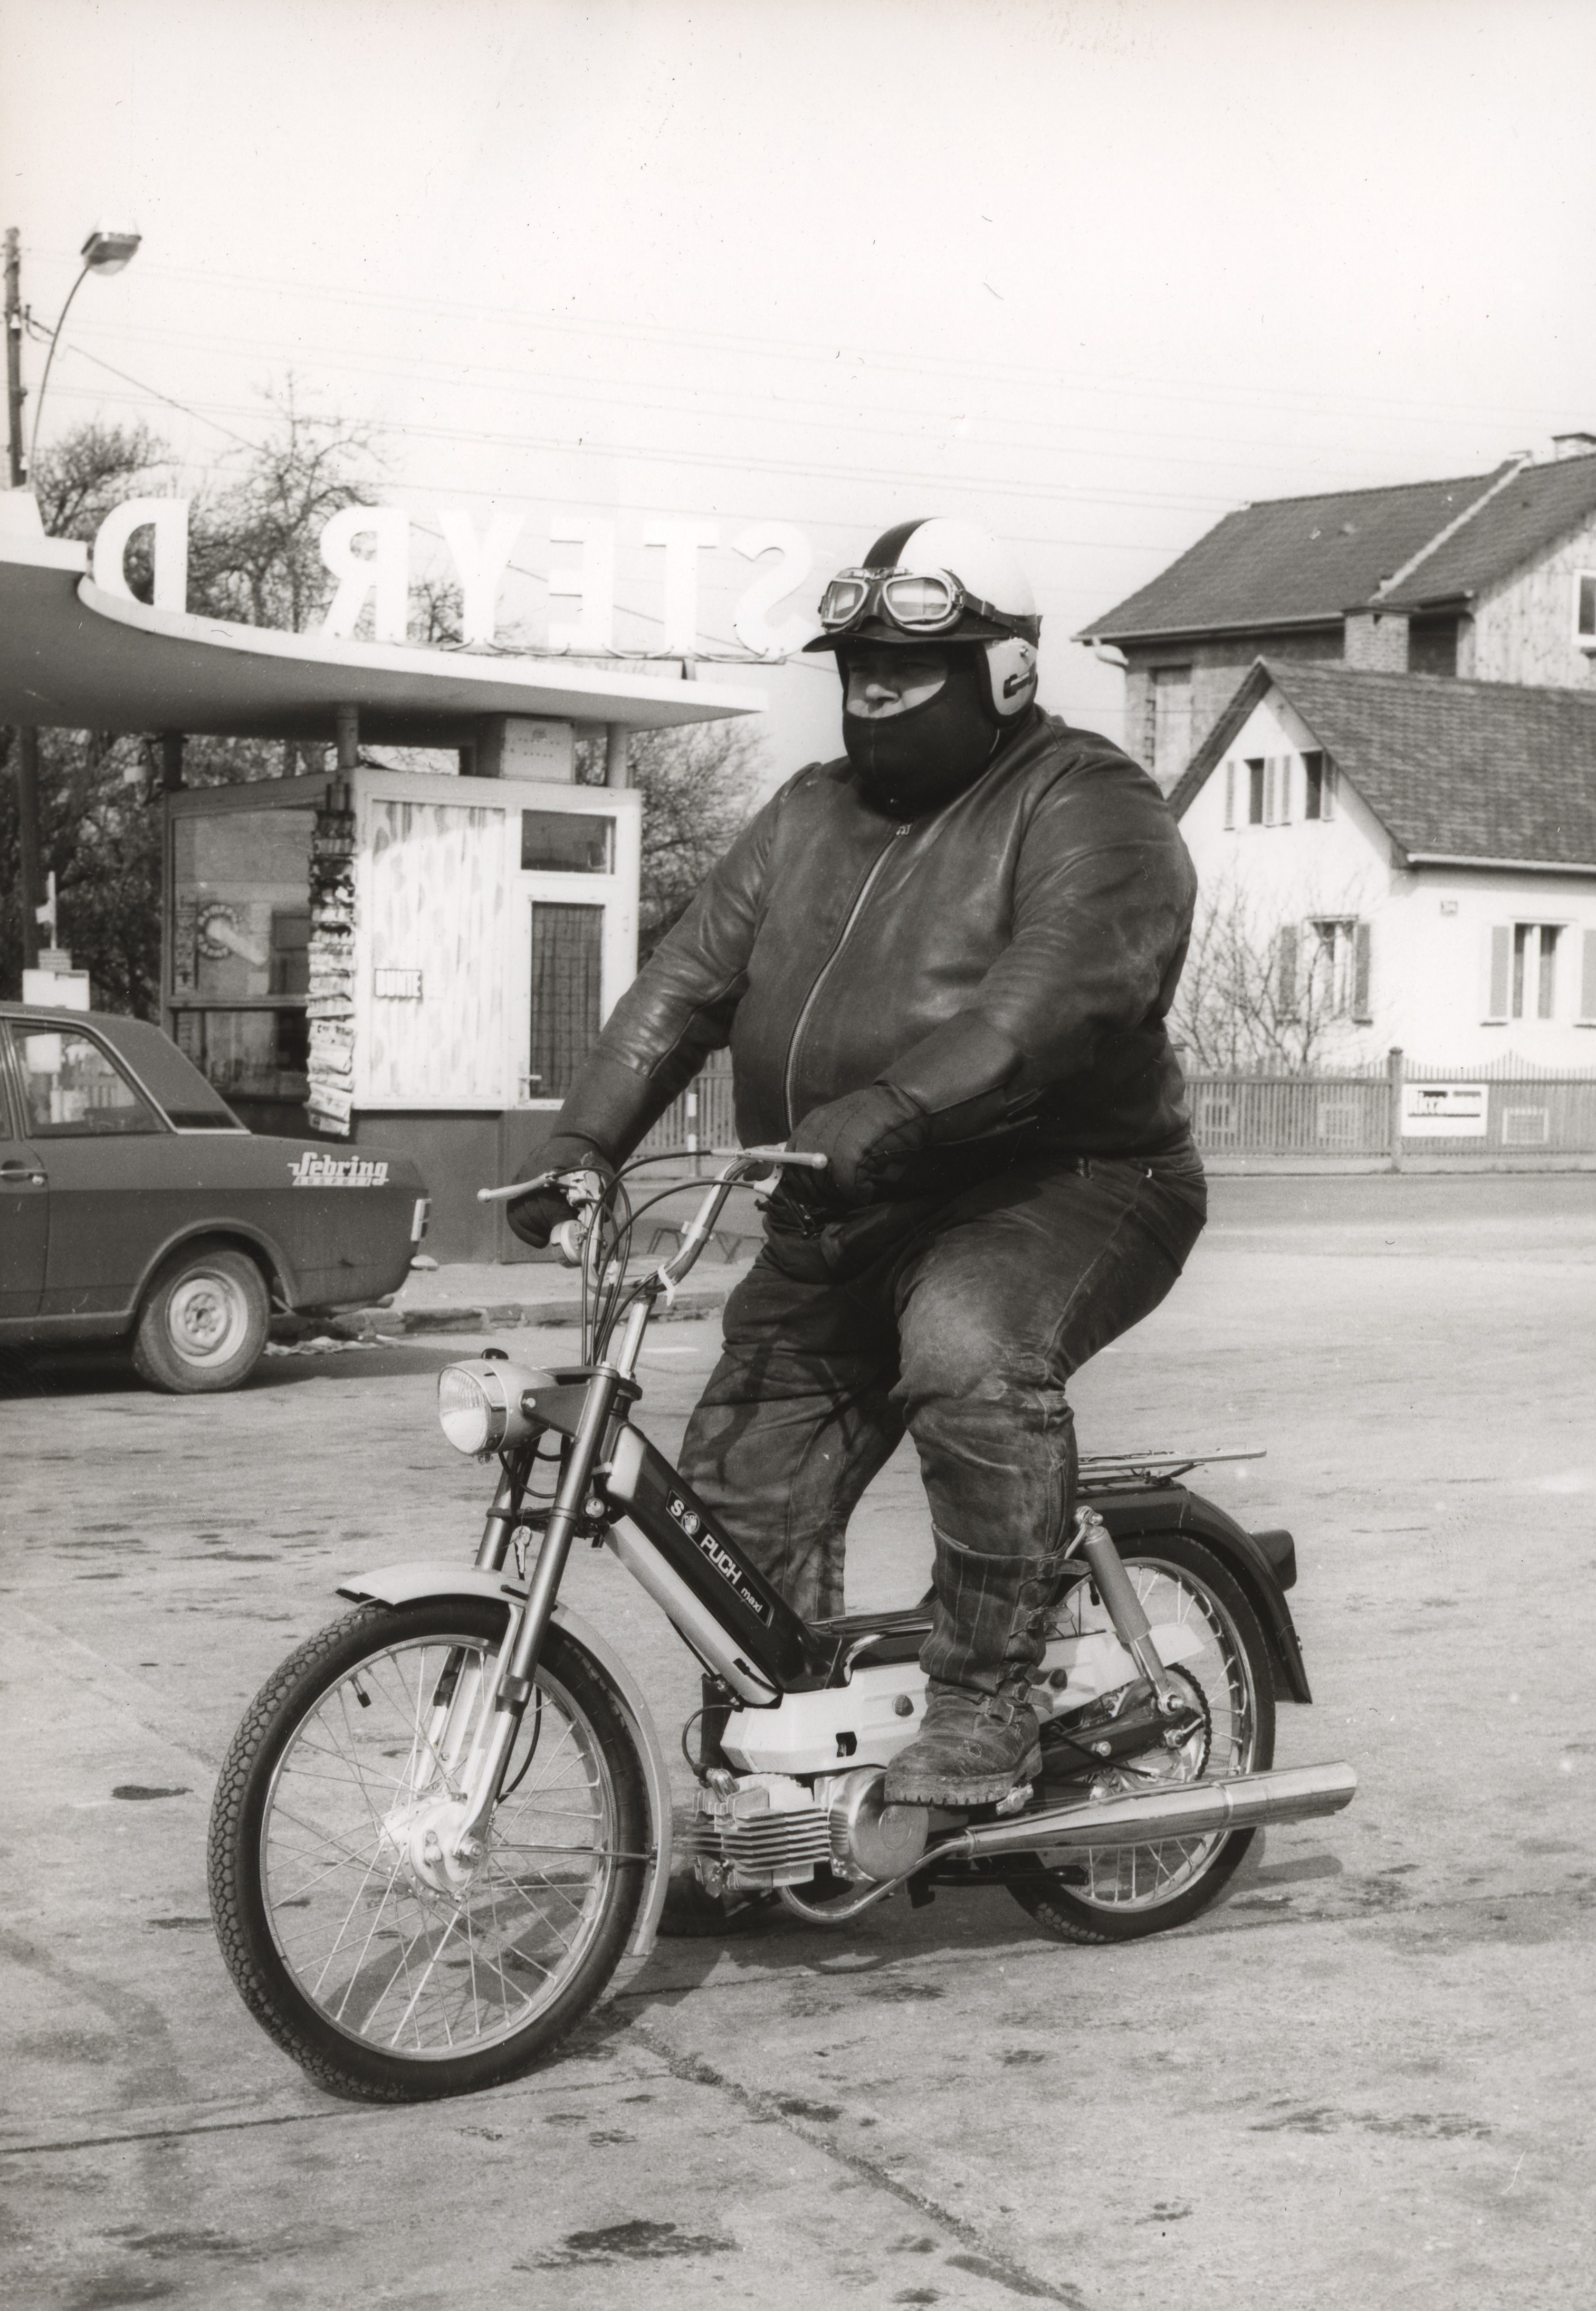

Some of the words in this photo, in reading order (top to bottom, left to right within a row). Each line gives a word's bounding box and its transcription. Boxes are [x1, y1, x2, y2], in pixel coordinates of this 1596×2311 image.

[287, 1152, 390, 1186] Sebring
[671, 1500, 684, 1516] S
[700, 1533, 742, 1585] PUCH
[741, 1587, 763, 1613] maxi
